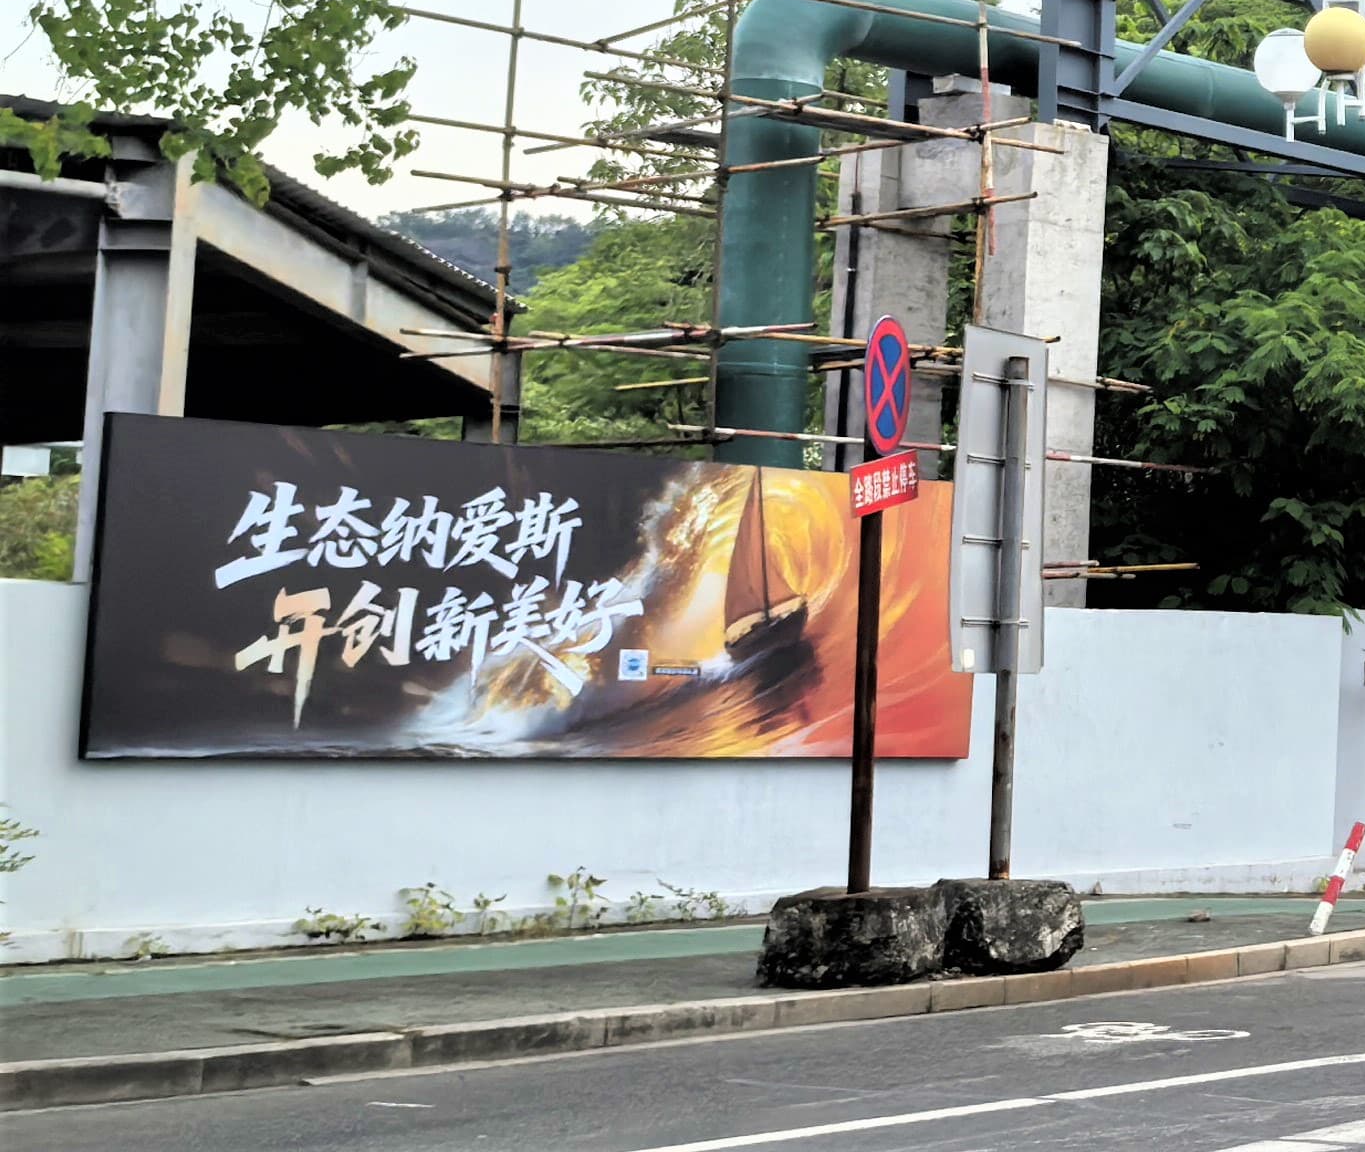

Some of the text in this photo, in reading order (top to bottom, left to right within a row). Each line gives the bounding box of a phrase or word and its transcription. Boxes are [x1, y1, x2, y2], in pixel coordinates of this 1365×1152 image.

[215, 481, 583, 590] 生态纳爱斯
[854, 460, 917, 509] 全路段禁止停车
[235, 575, 644, 730] 开创新美好
